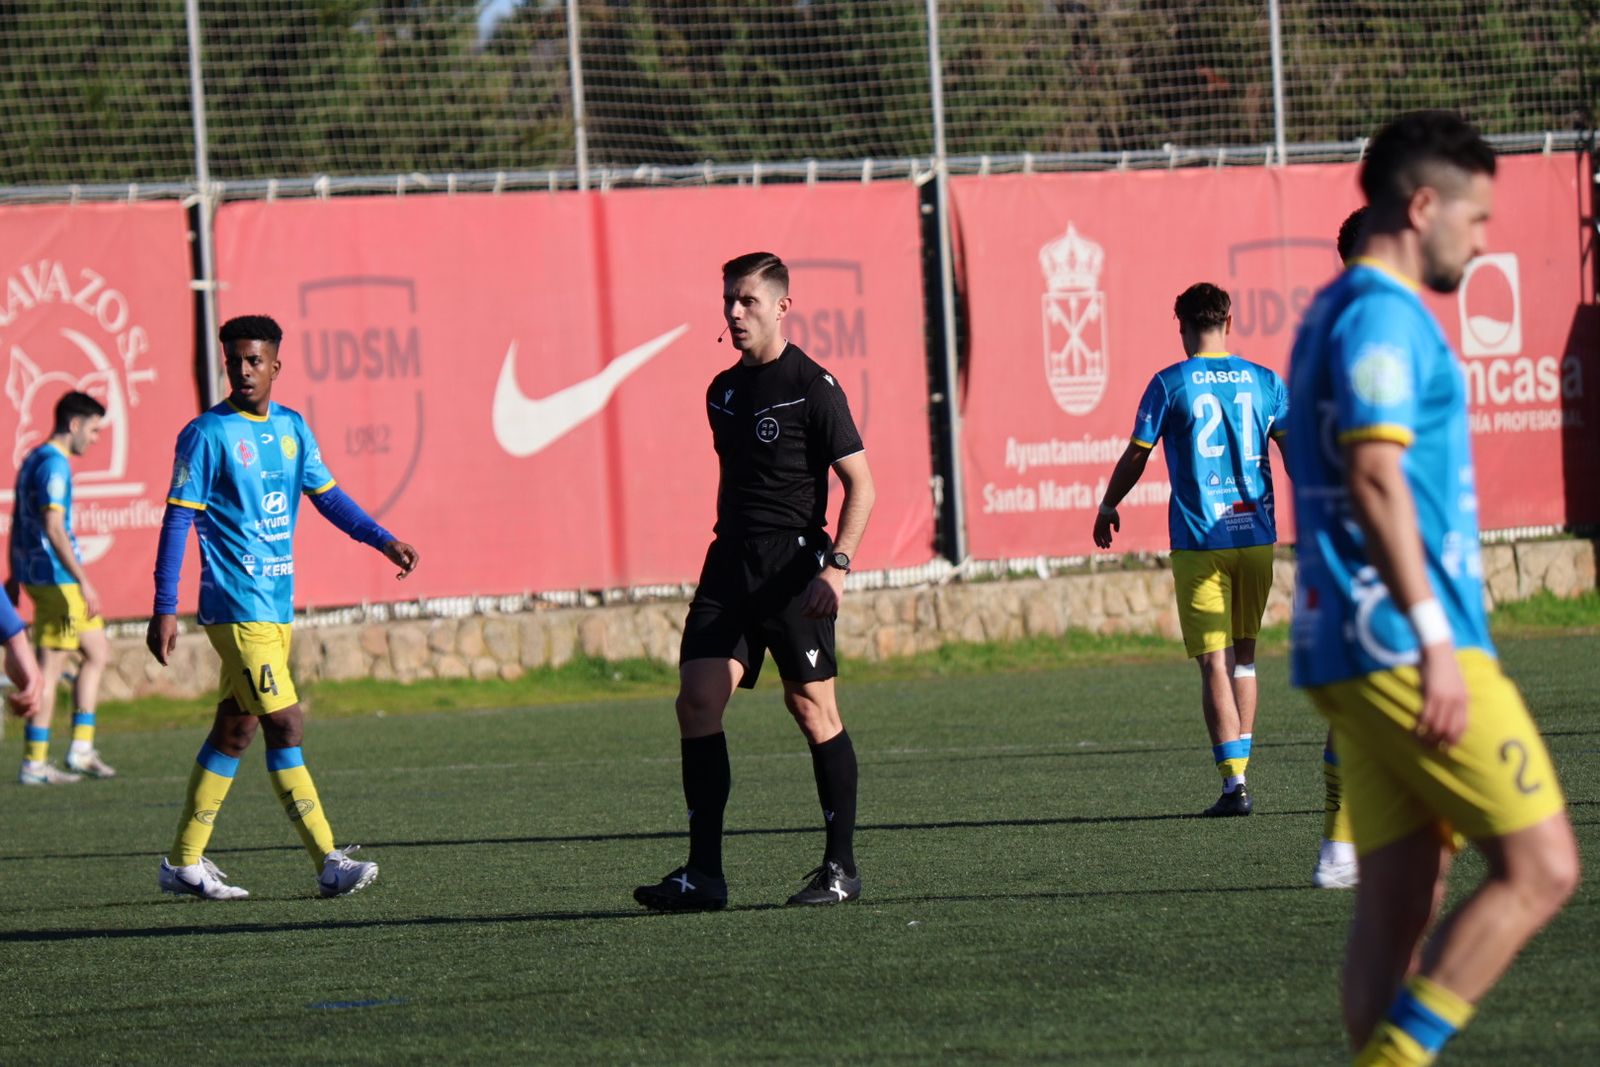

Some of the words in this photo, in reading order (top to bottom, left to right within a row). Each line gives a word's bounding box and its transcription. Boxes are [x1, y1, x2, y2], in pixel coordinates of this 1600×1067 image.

[302, 326, 422, 382] UDSM
[784, 308, 868, 359] DSM
[1192, 371, 1253, 385] CASCA
[1460, 355, 1584, 407] ncasa
[1193, 392, 1257, 460] 21
[983, 482, 1036, 514] Santa
[1038, 479, 1091, 511] Marta
[242, 663, 279, 702] 14
[1498, 738, 1541, 795] 2
